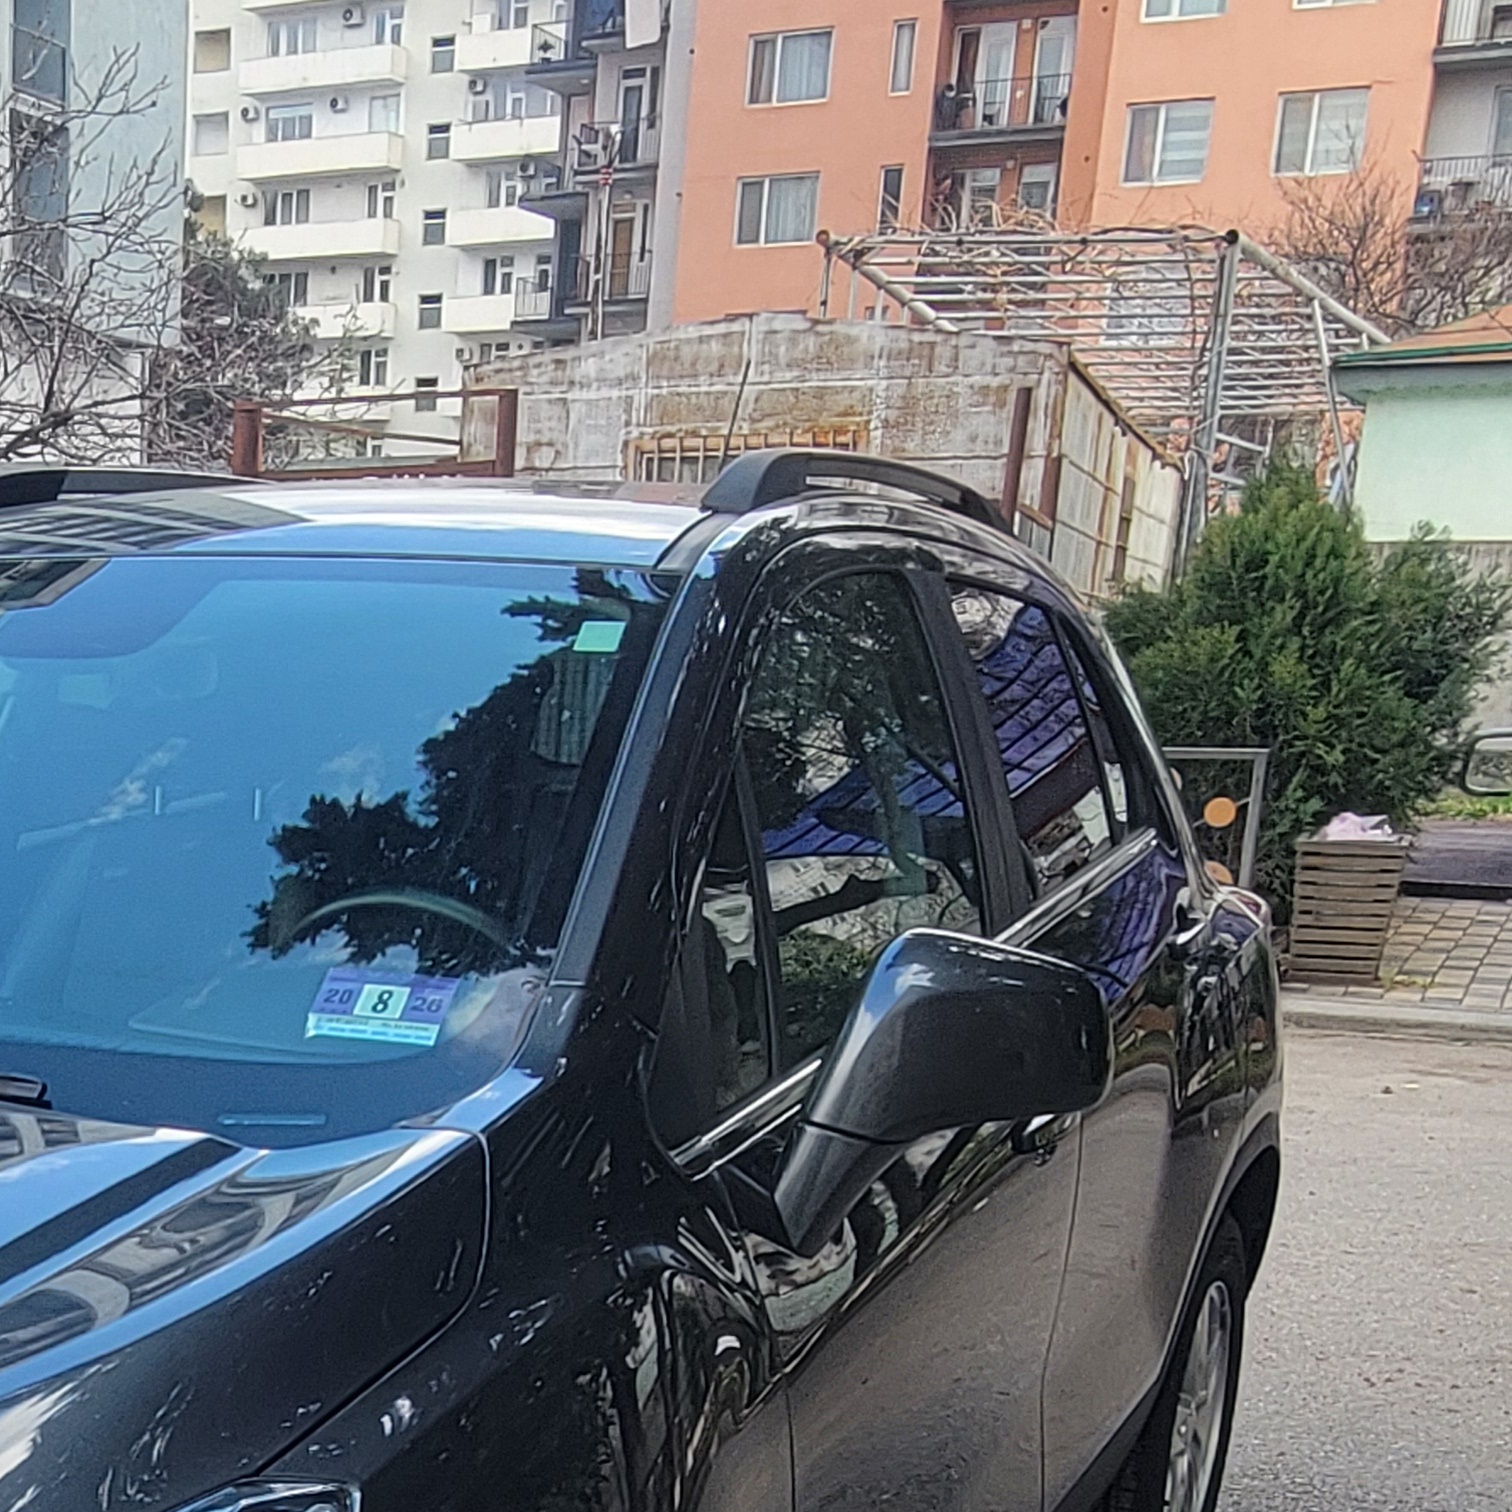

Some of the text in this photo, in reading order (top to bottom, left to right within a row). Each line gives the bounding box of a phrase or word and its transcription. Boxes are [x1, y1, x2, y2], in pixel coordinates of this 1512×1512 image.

[323, 988, 443, 1014] 20 8 26
